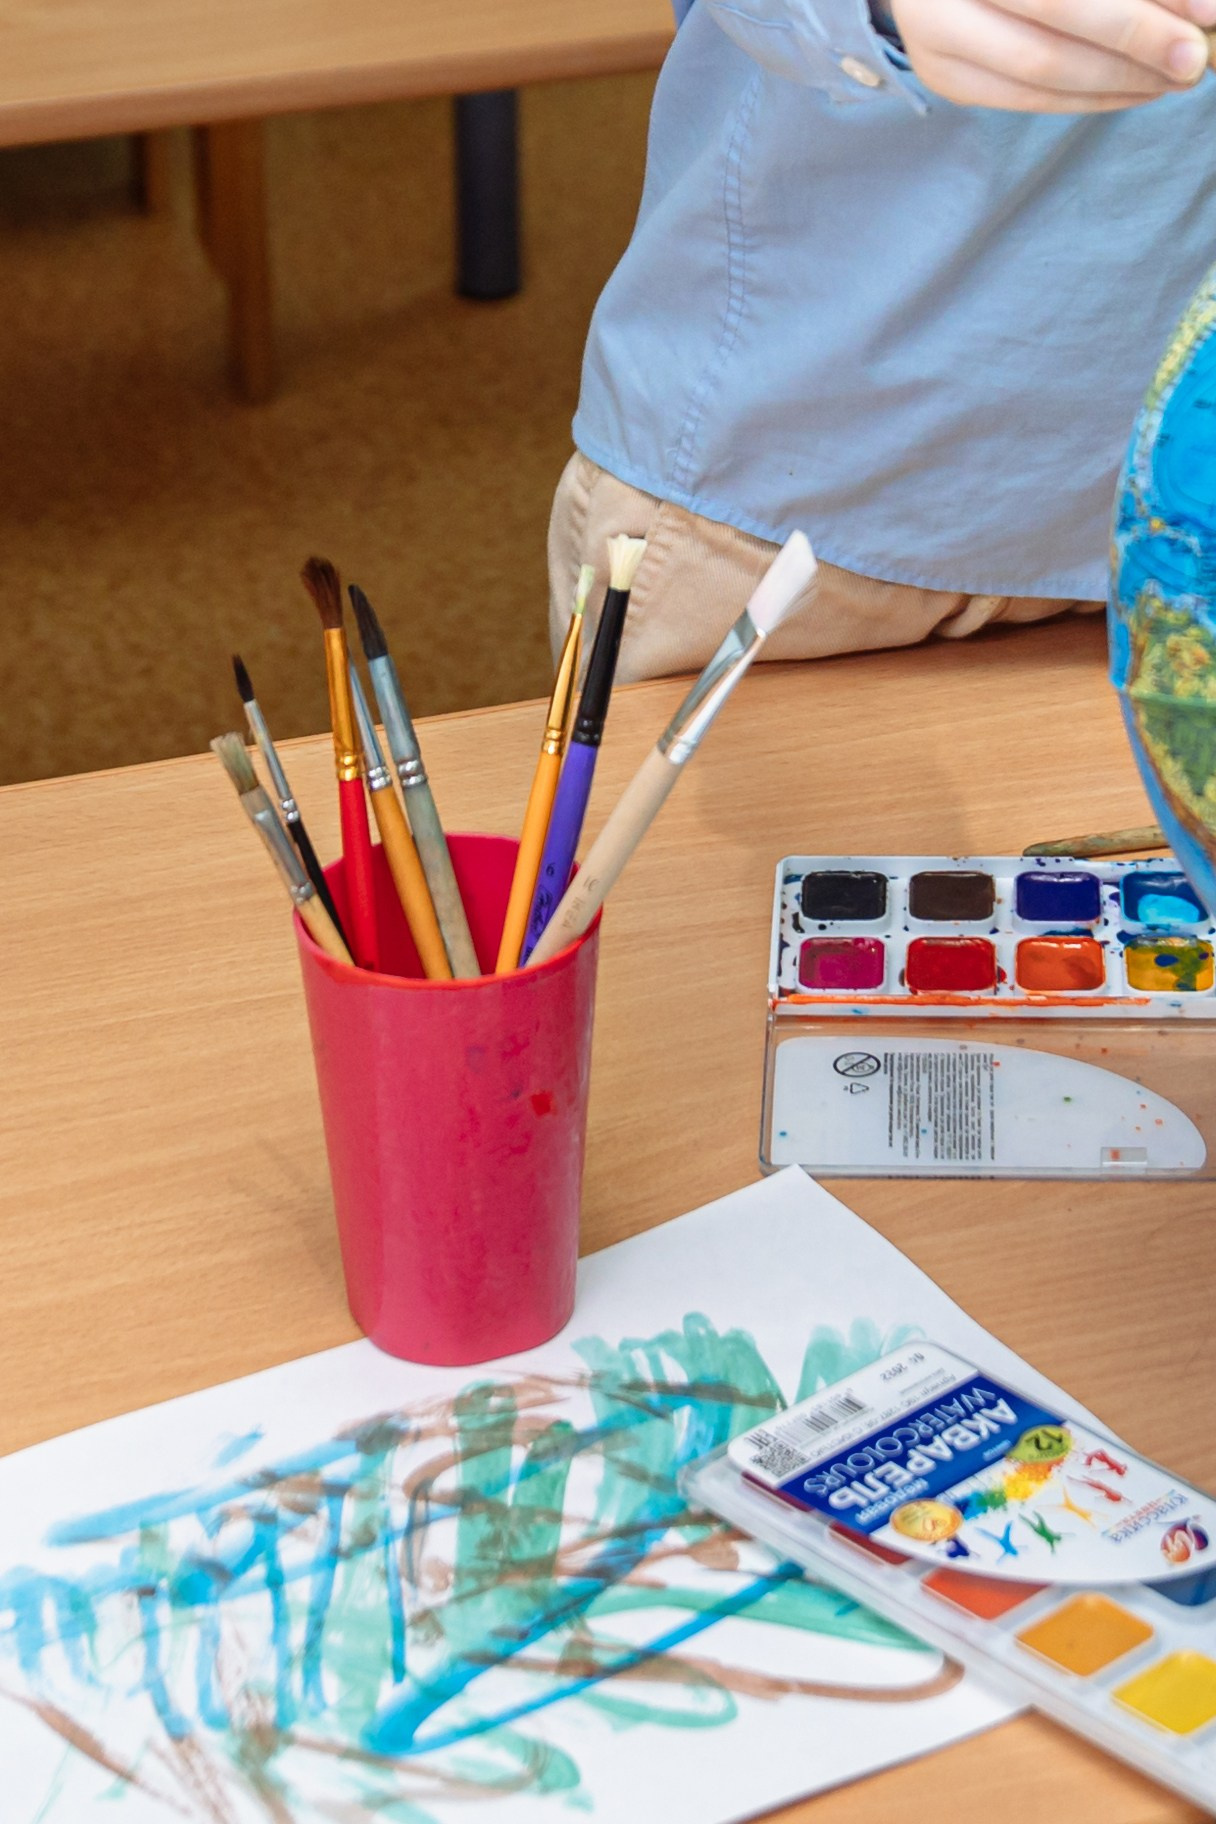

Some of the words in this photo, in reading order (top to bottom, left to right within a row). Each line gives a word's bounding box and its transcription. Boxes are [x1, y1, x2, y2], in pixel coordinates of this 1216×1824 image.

[803, 1387, 996, 1498] WATERCOLOURS
[828, 1397, 1018, 1510] АКВАРЕЛЬ
[1025, 1428, 1064, 1452] 12
